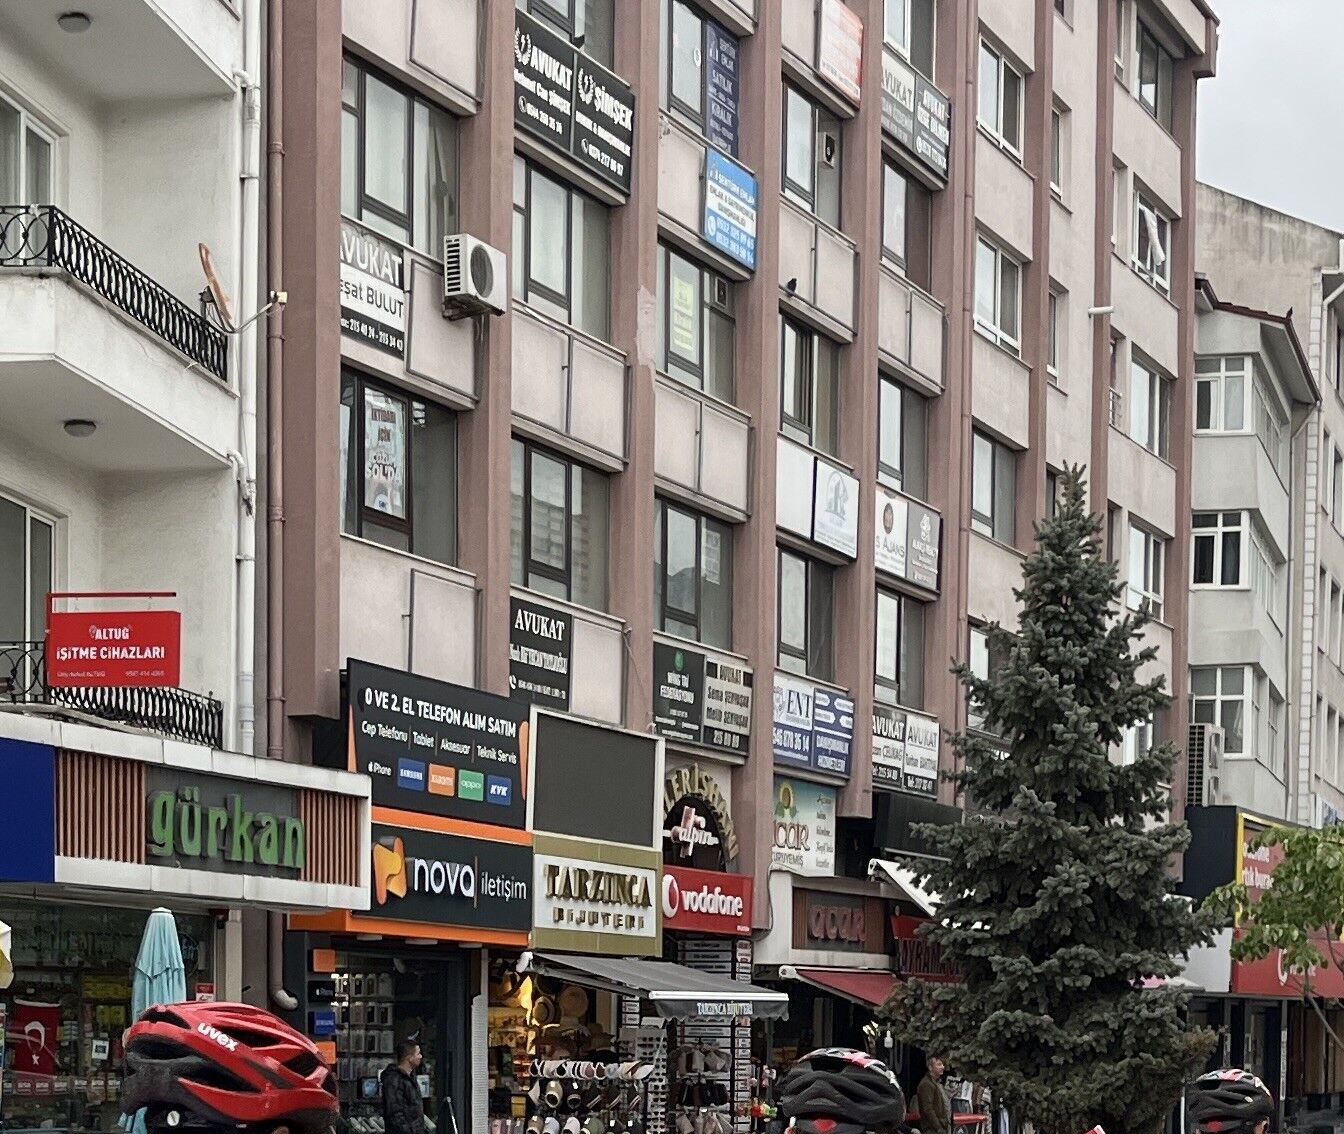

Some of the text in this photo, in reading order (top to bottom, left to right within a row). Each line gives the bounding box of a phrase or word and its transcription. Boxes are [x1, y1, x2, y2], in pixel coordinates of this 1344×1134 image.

[530, 45, 572, 91] AVUKAT
[594, 85, 633, 132] ŞİMŞEK
[367, 285, 404, 318] BULUT
[514, 608, 565, 641] AVUKAT
[374, 690, 388, 709] VE
[391, 693, 401, 712] 2.
[402, 696, 415, 716] EL
[416, 700, 461, 726] TELEFON
[462, 711, 486, 731] ALIM
[488, 716, 517, 738] SATIM
[361, 720, 376, 737] Cep
[412, 731, 435, 748] Tablet
[497, 750, 517, 765] Servis
[908, 726, 937, 748] AVUKAT
[490, 784, 508, 797] KVK
[146, 786, 305, 870] gürkan
[413, 857, 527, 902] nova iletişim
[681, 885, 743, 917] vodafone
[197, 1023, 238, 1052] uvex
